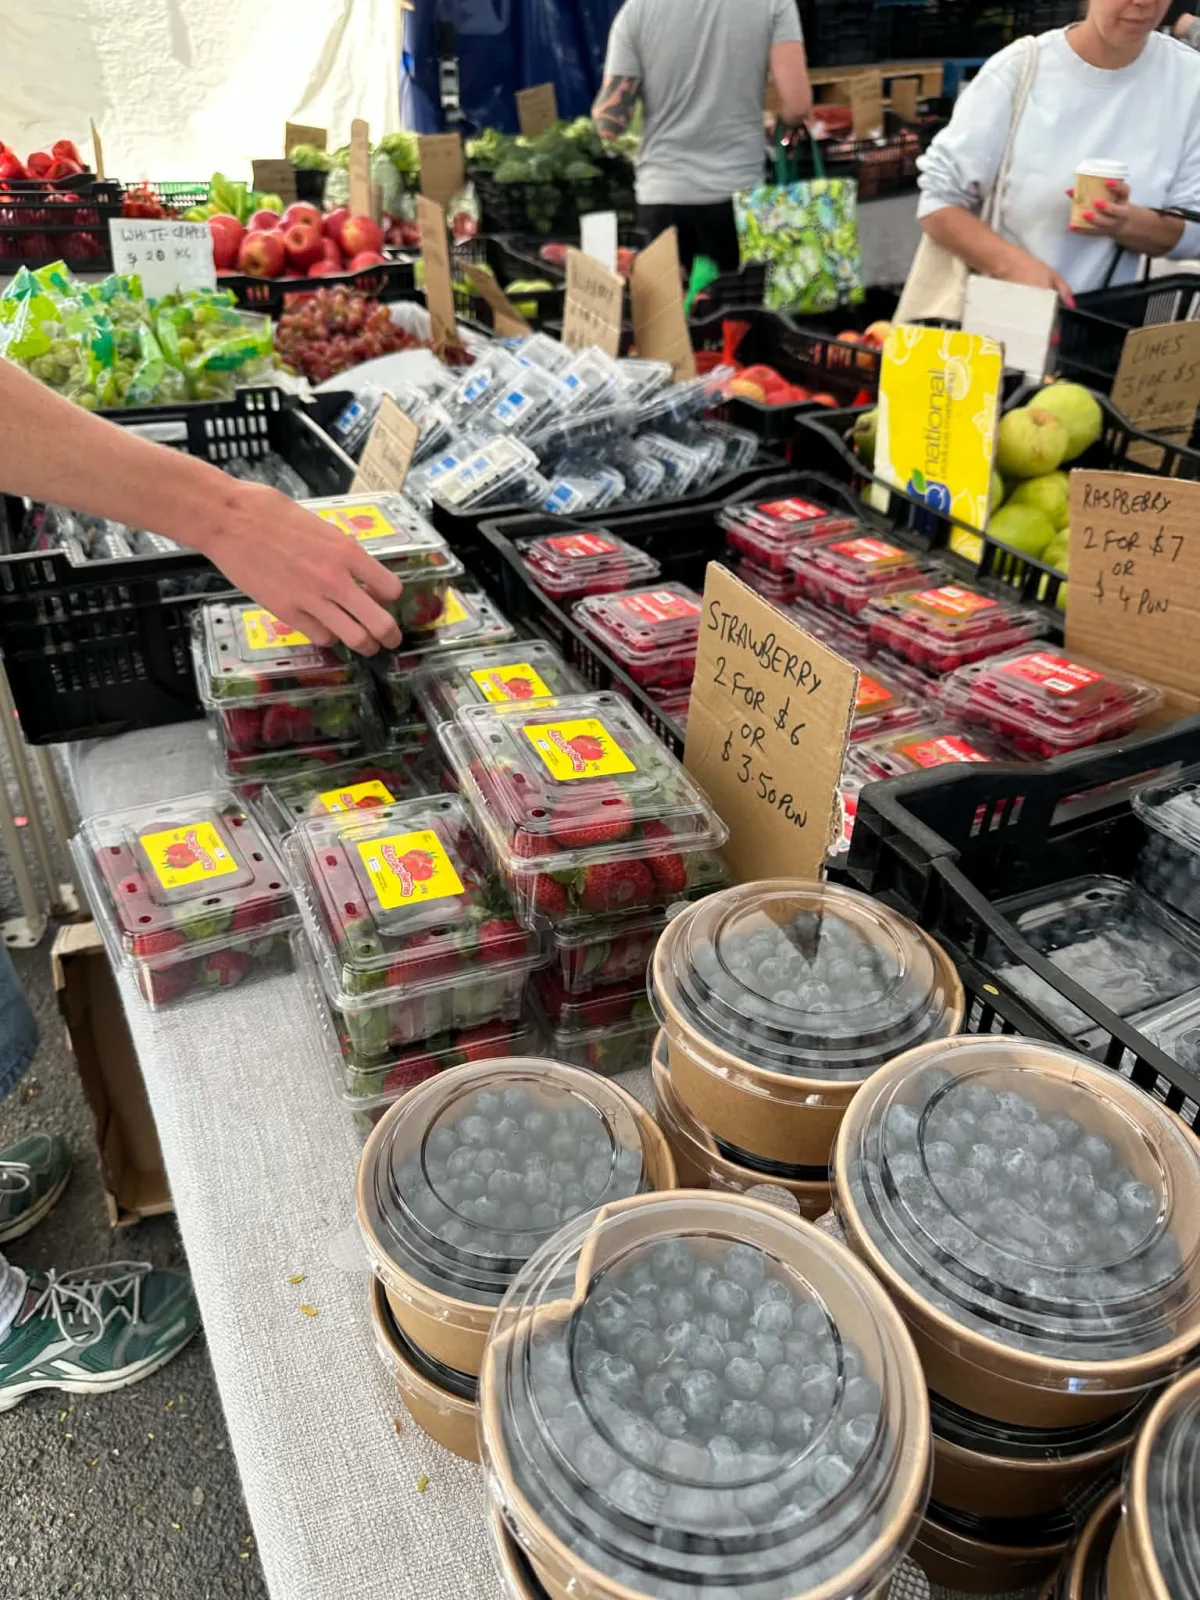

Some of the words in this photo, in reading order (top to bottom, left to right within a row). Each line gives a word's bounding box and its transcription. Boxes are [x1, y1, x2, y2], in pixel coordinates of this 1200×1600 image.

[1131, 333, 1185, 365] LIMES
[1121, 375, 1136, 399] 3
[923, 367, 946, 478] national
[1082, 483, 1172, 515] RASPBERRY
[1083, 526, 1098, 550] 2
[1103, 529, 1141, 553] FOR
[1111, 559, 1135, 576] OR
[1137, 588, 1169, 615] PUN
[707, 599, 822, 695] STRAWBERRY
[713, 656, 727, 687] 2
[731, 671, 766, 714] FOR
[740, 723, 766, 753] OR
